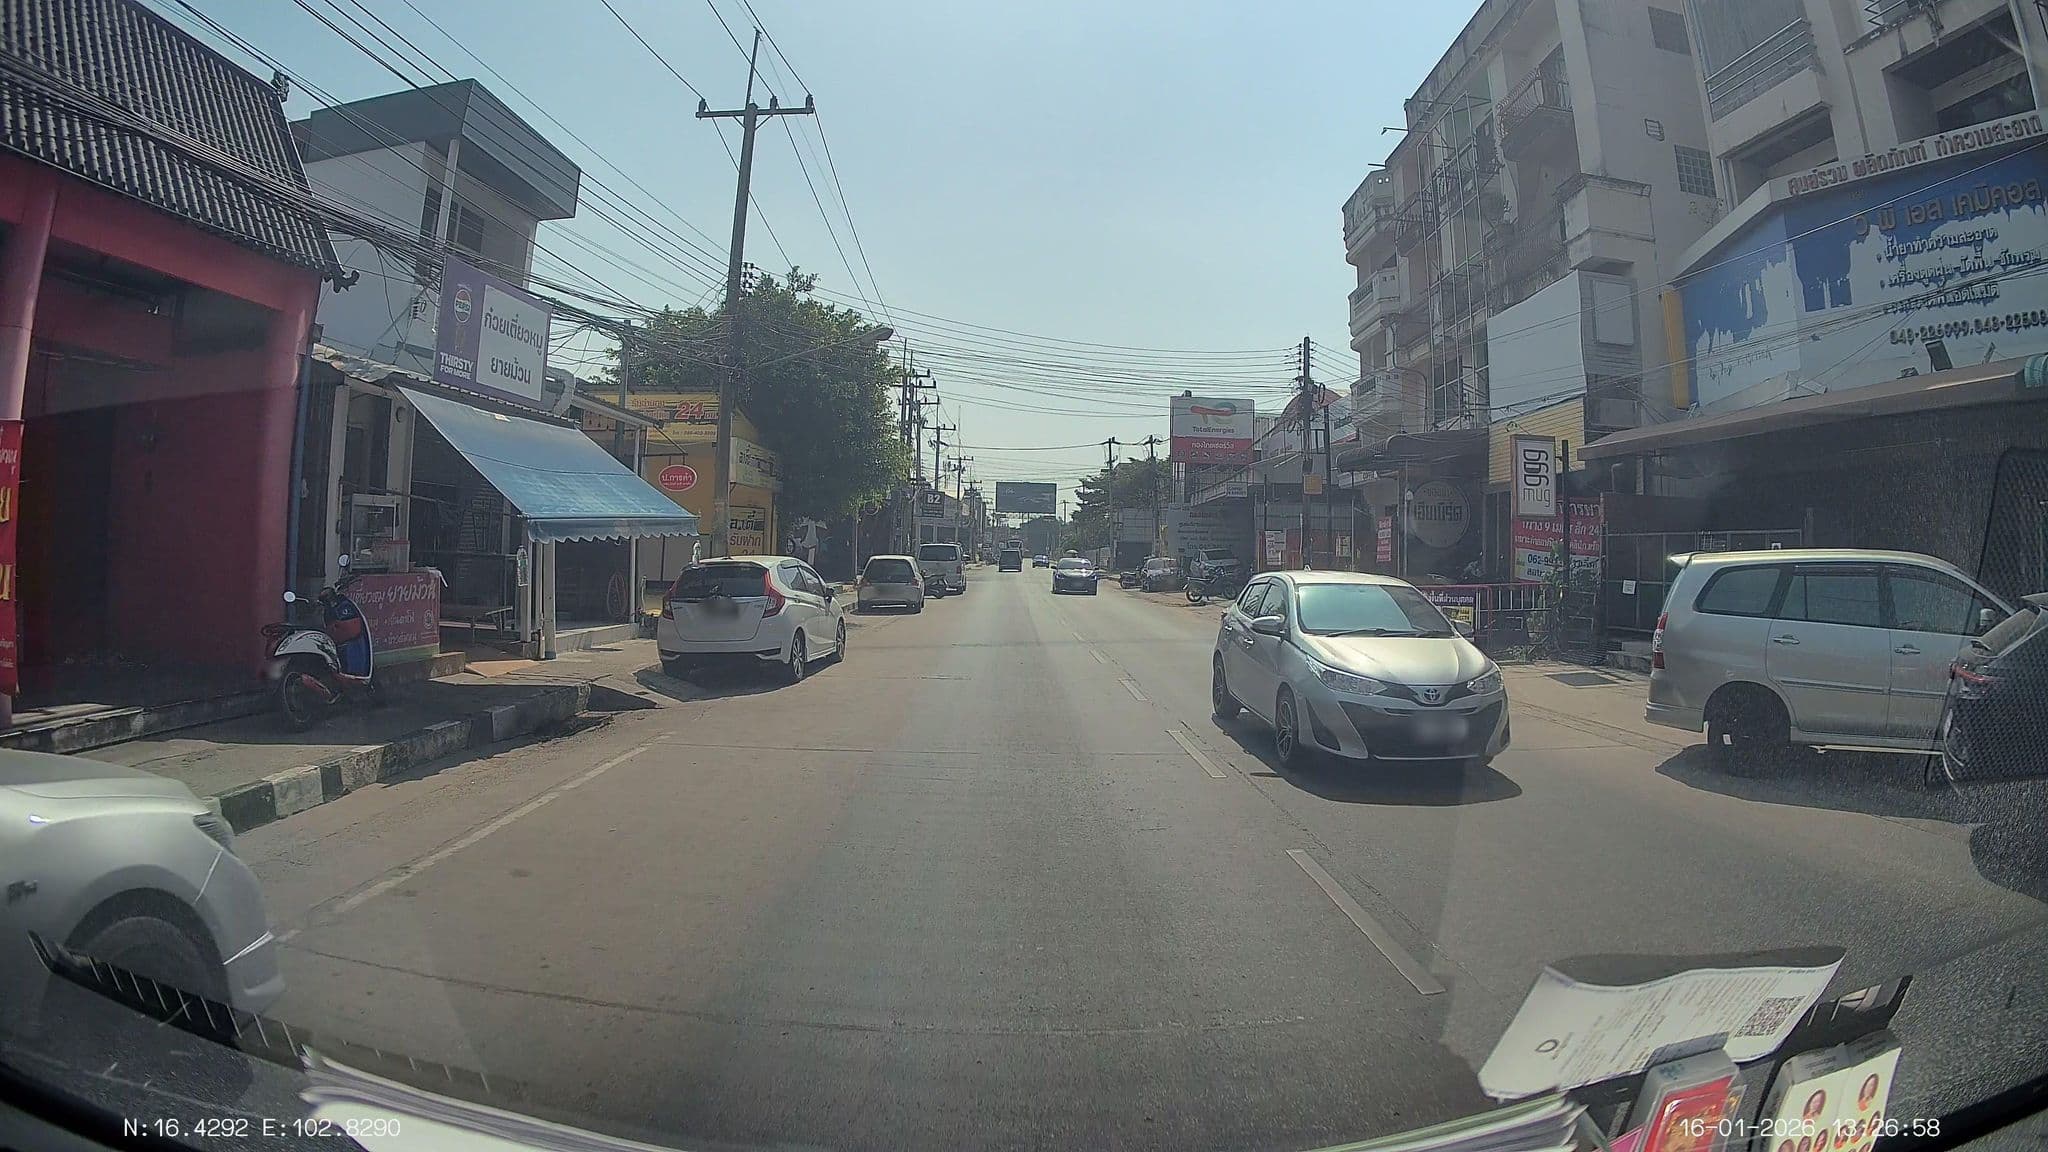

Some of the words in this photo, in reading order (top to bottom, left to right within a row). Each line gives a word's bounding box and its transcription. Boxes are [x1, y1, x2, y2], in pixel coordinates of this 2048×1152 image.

[439, 351, 474, 373] THIRSTY
[440, 364, 453, 375] FOR
[453, 368, 472, 380] MORE
[674, 400, 705, 420] 24
[1192, 425, 1235, 434] TotalEnergies
[927, 493, 941, 504] B2
[1523, 488, 1551, 508] mug
[1552, 522, 1573, 534] เมร
